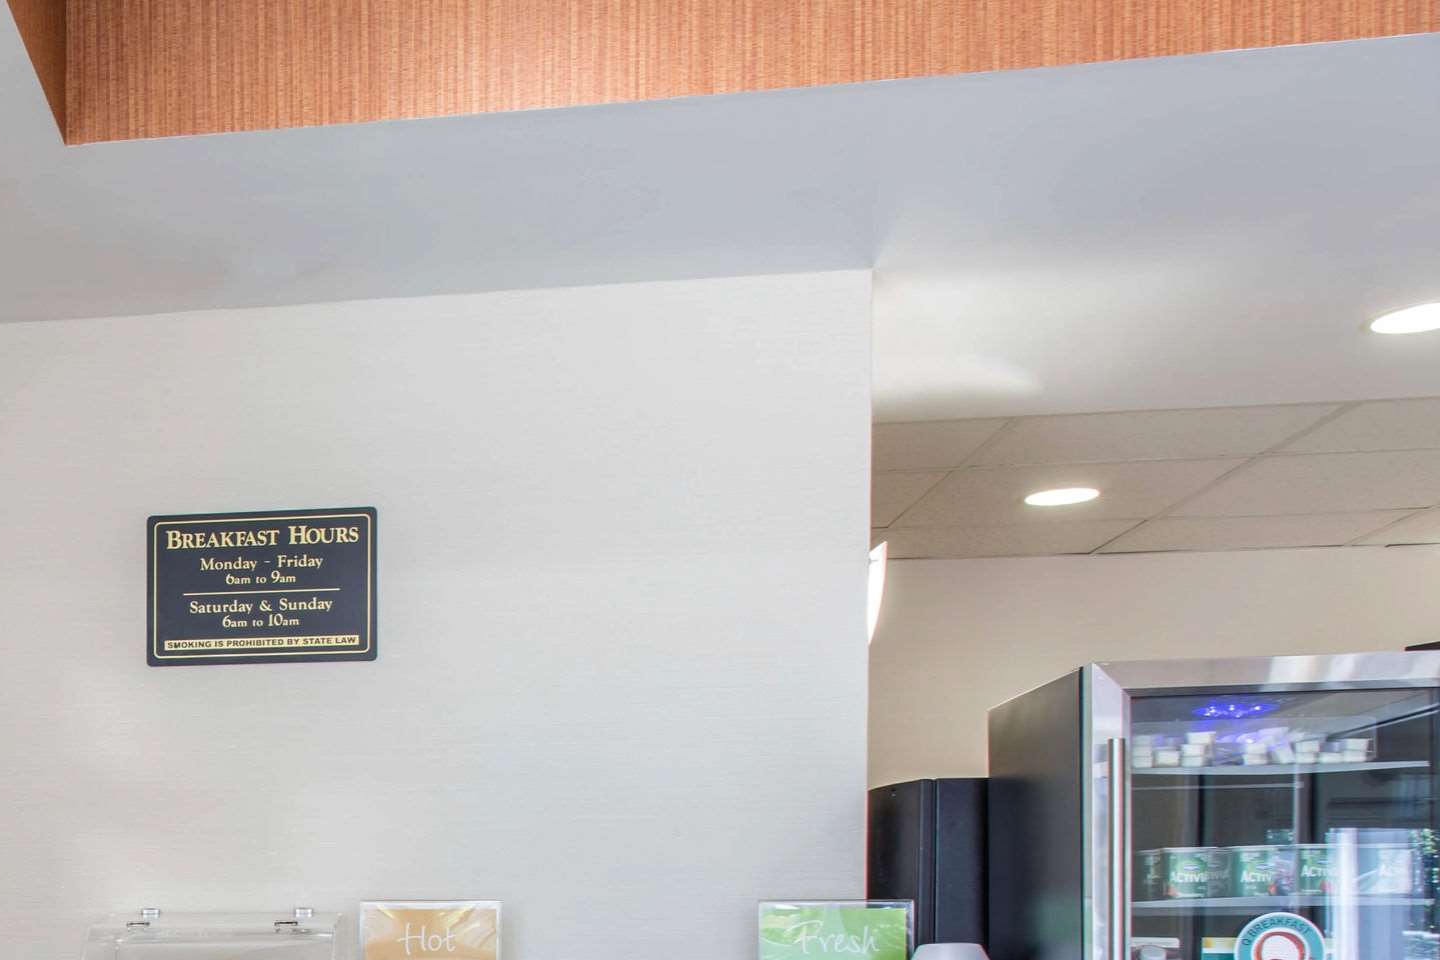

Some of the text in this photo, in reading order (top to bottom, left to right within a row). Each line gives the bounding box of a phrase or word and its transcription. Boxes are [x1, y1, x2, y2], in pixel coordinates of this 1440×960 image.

[166, 526, 360, 549] BREAKFAST HOURS
[200, 557, 257, 571] Monday
[277, 555, 323, 568] Friday
[225, 571, 296, 585] 6am to 9am
[190, 597, 333, 614] Saturday & Sunday
[222, 613, 300, 628] 6am to 10am
[167, 634, 356, 649] SMOKING IS PROHIBITED BY STATE LAW
[783, 919, 880, 954] Fresh
[1248, 918, 1312, 938] BREAKFAST
[396, 922, 457, 955] Hot
